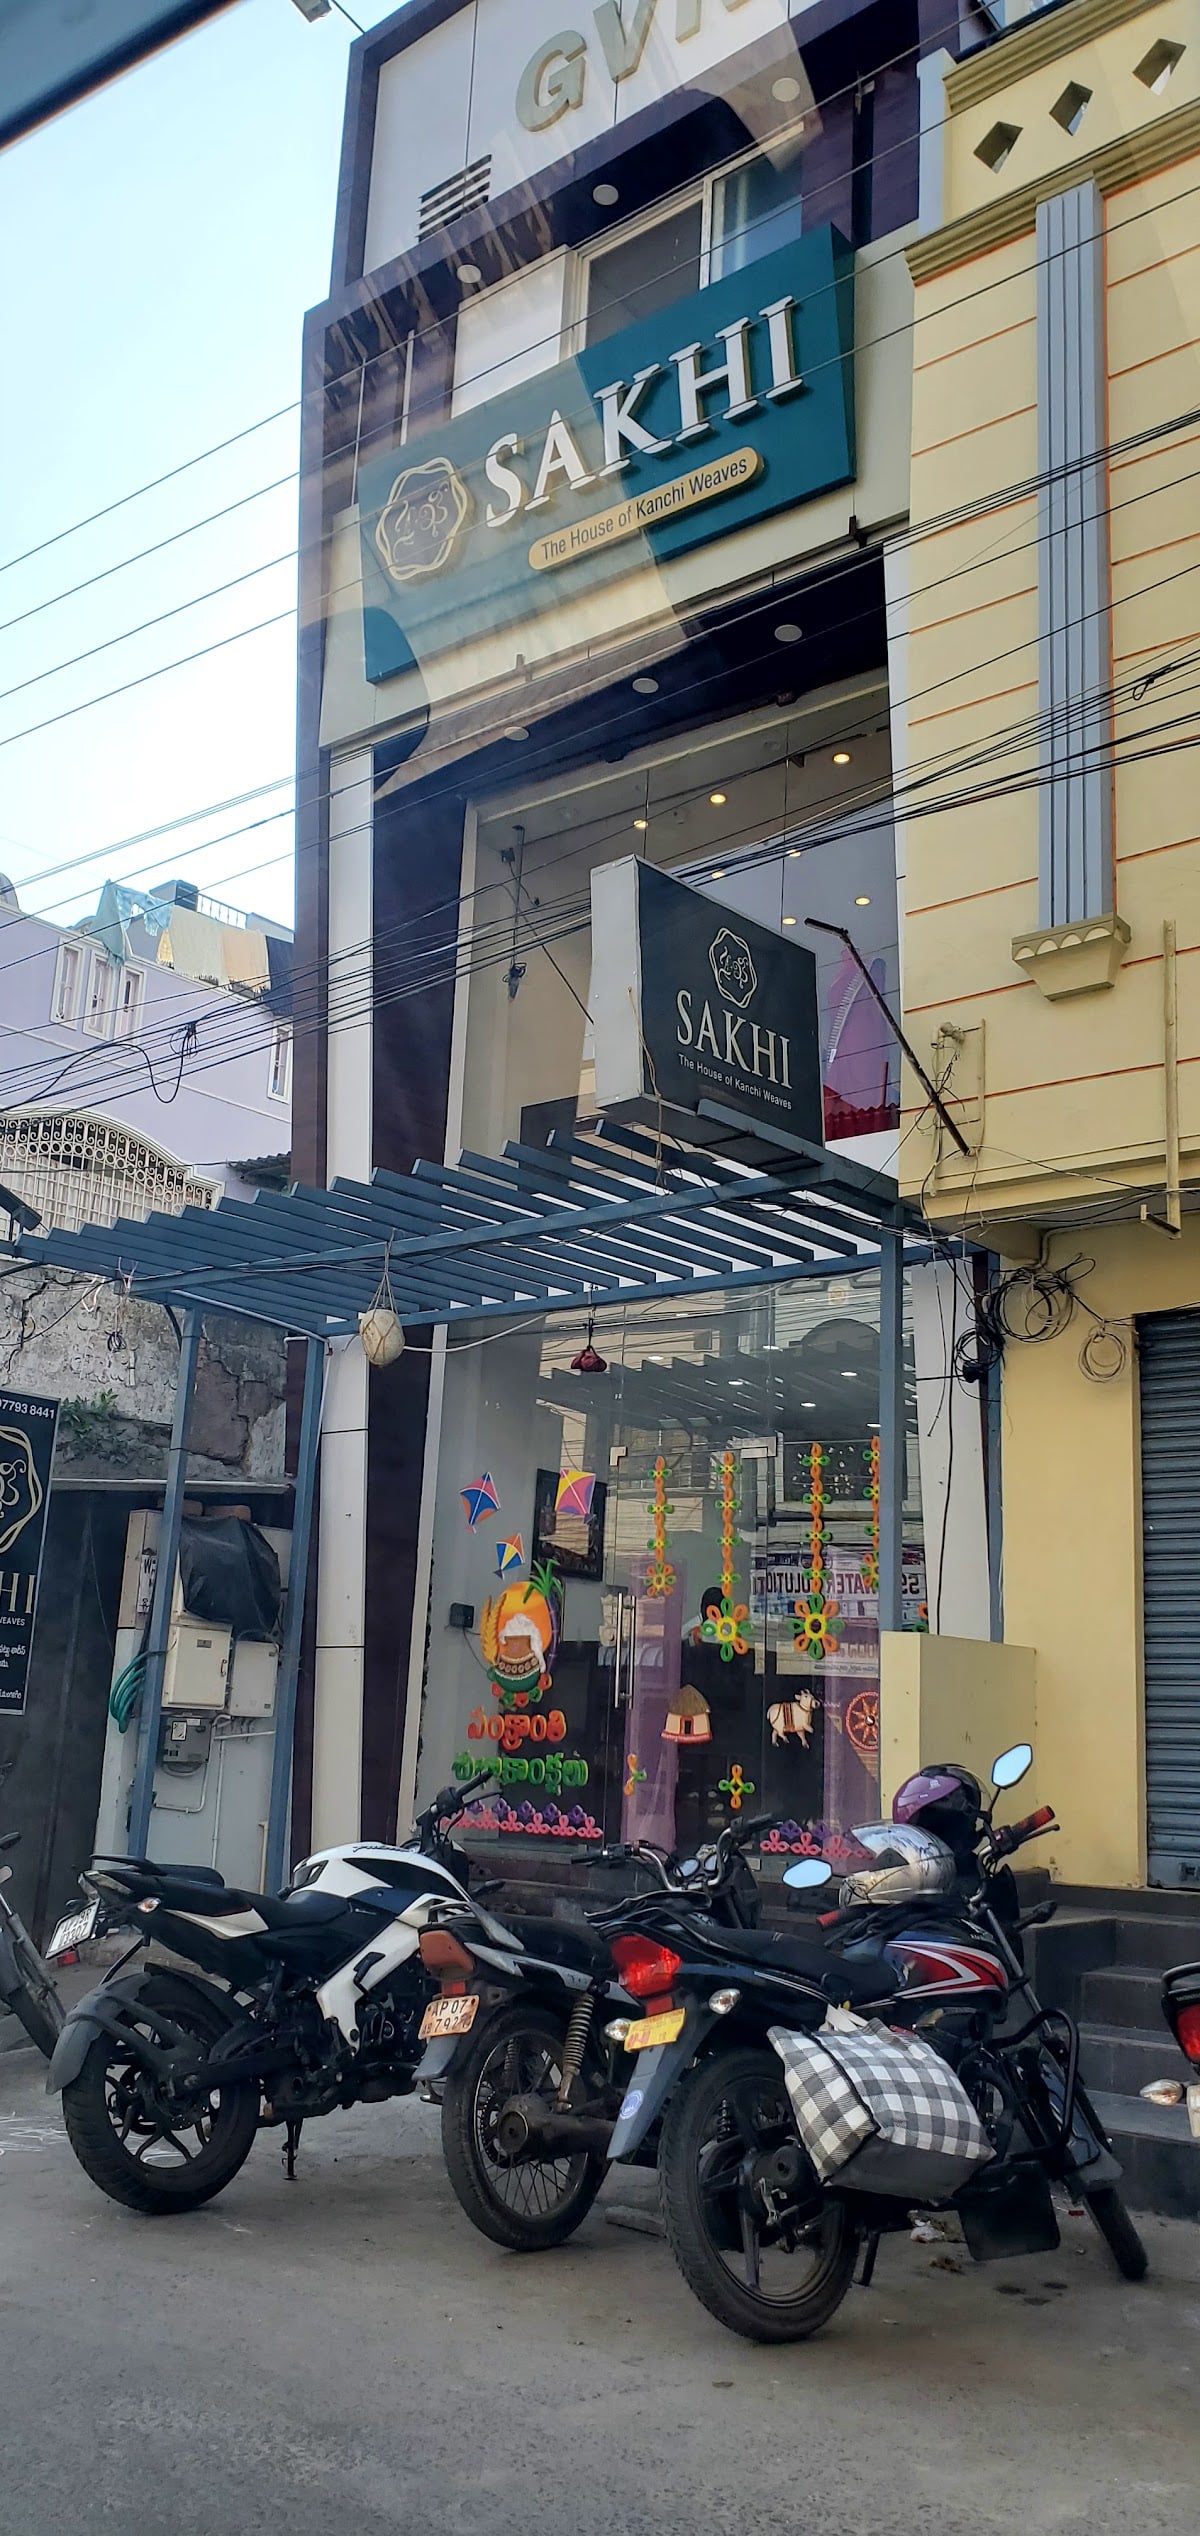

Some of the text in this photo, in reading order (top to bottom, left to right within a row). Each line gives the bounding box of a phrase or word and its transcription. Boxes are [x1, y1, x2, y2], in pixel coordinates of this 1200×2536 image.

[485, 295, 803, 528] SAKHI
[541, 459, 748, 561] The House of Kanchi Weaves
[676, 989, 793, 1089] SAKHI
[678, 1053, 792, 1110] The House of Kanchi Weaves
[0, 1399, 55, 1419] 7793 8441
[431, 1999, 468, 2017] AP 07
